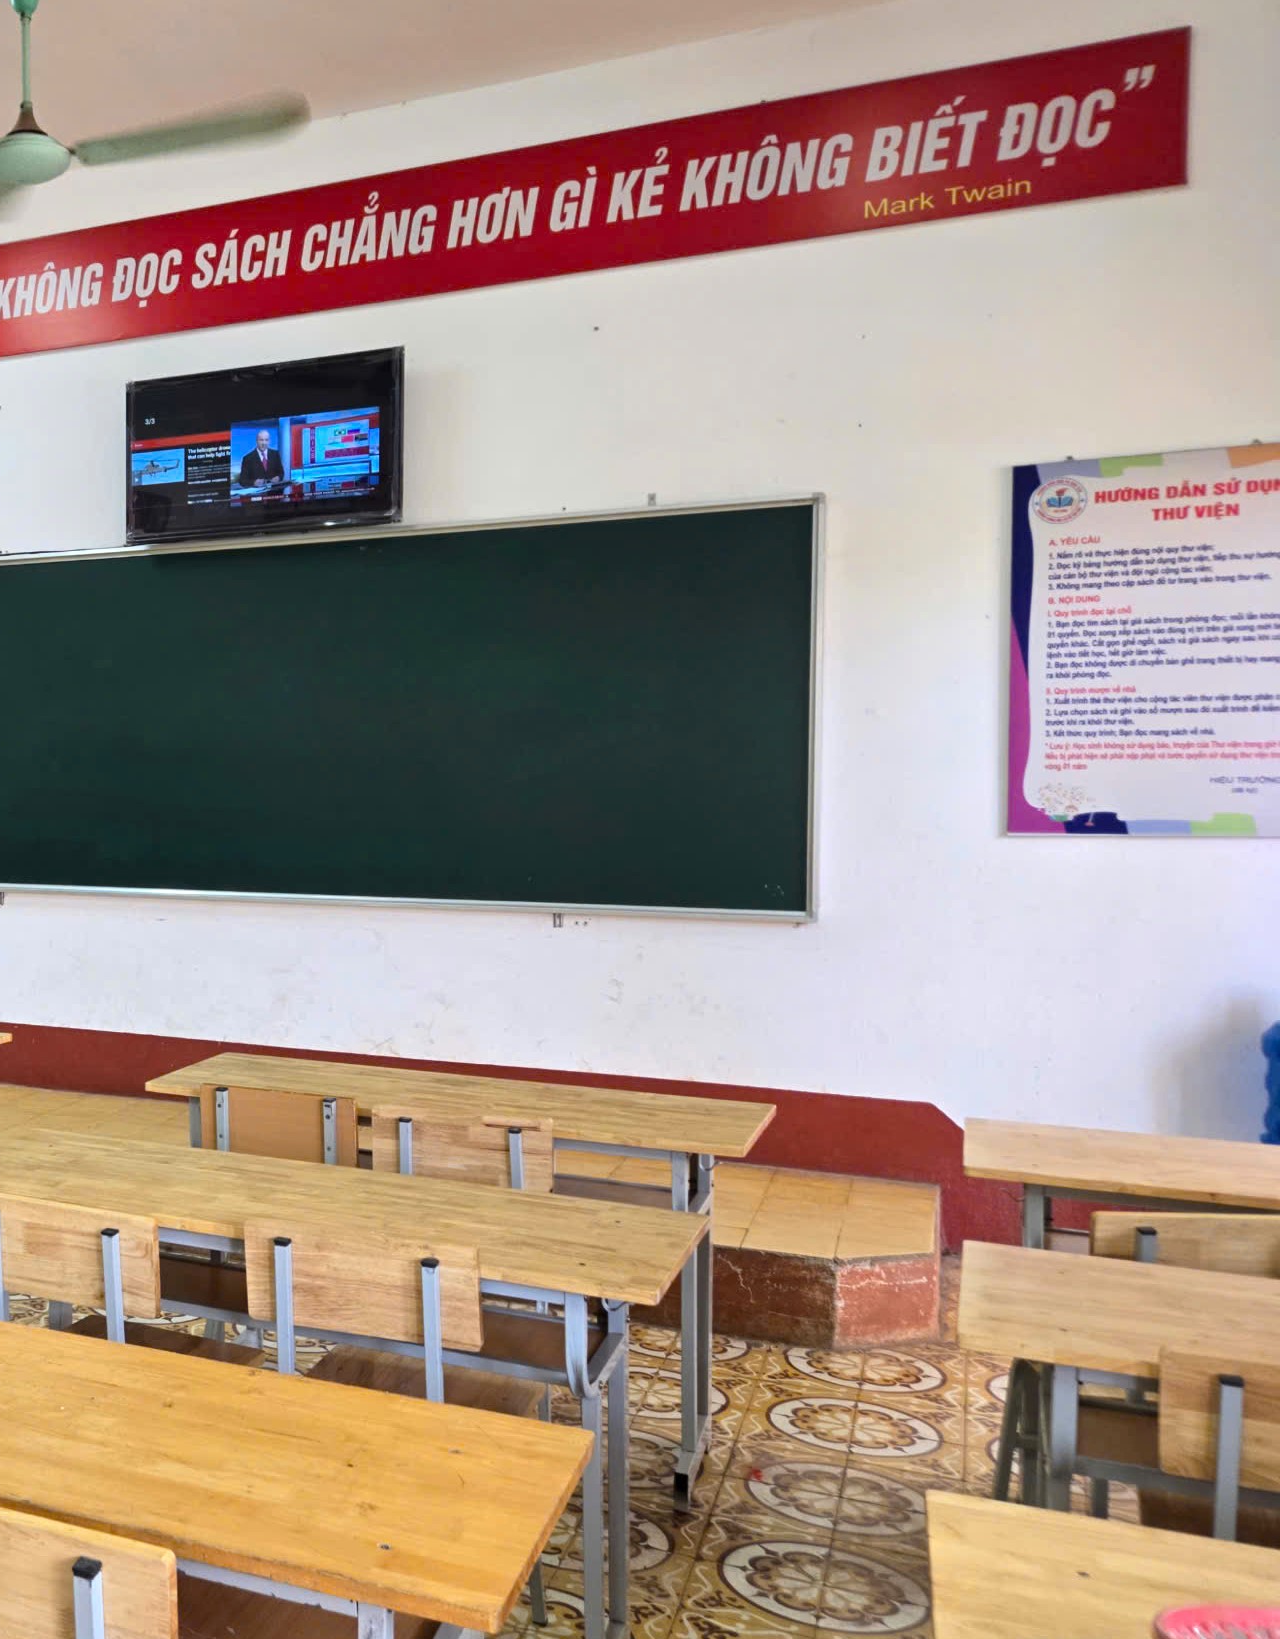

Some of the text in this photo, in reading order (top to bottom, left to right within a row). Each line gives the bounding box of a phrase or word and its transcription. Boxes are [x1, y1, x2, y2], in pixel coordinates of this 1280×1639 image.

[111, 248, 183, 308] ĐỌC
[190, 228, 291, 290] SÁCH
[300, 191, 437, 273] CHẲNG
[446, 186, 540, 250] HƠN
[548, 166, 597, 232] GÌ
[606, 147, 670, 225] KẺ
[679, 134, 854, 212] KHÔNG
[865, 96, 987, 183] BIẾT
[863, 177, 1032, 219] Mark Twain
[1152, 503, 1240, 521] THƯ VIỆN
